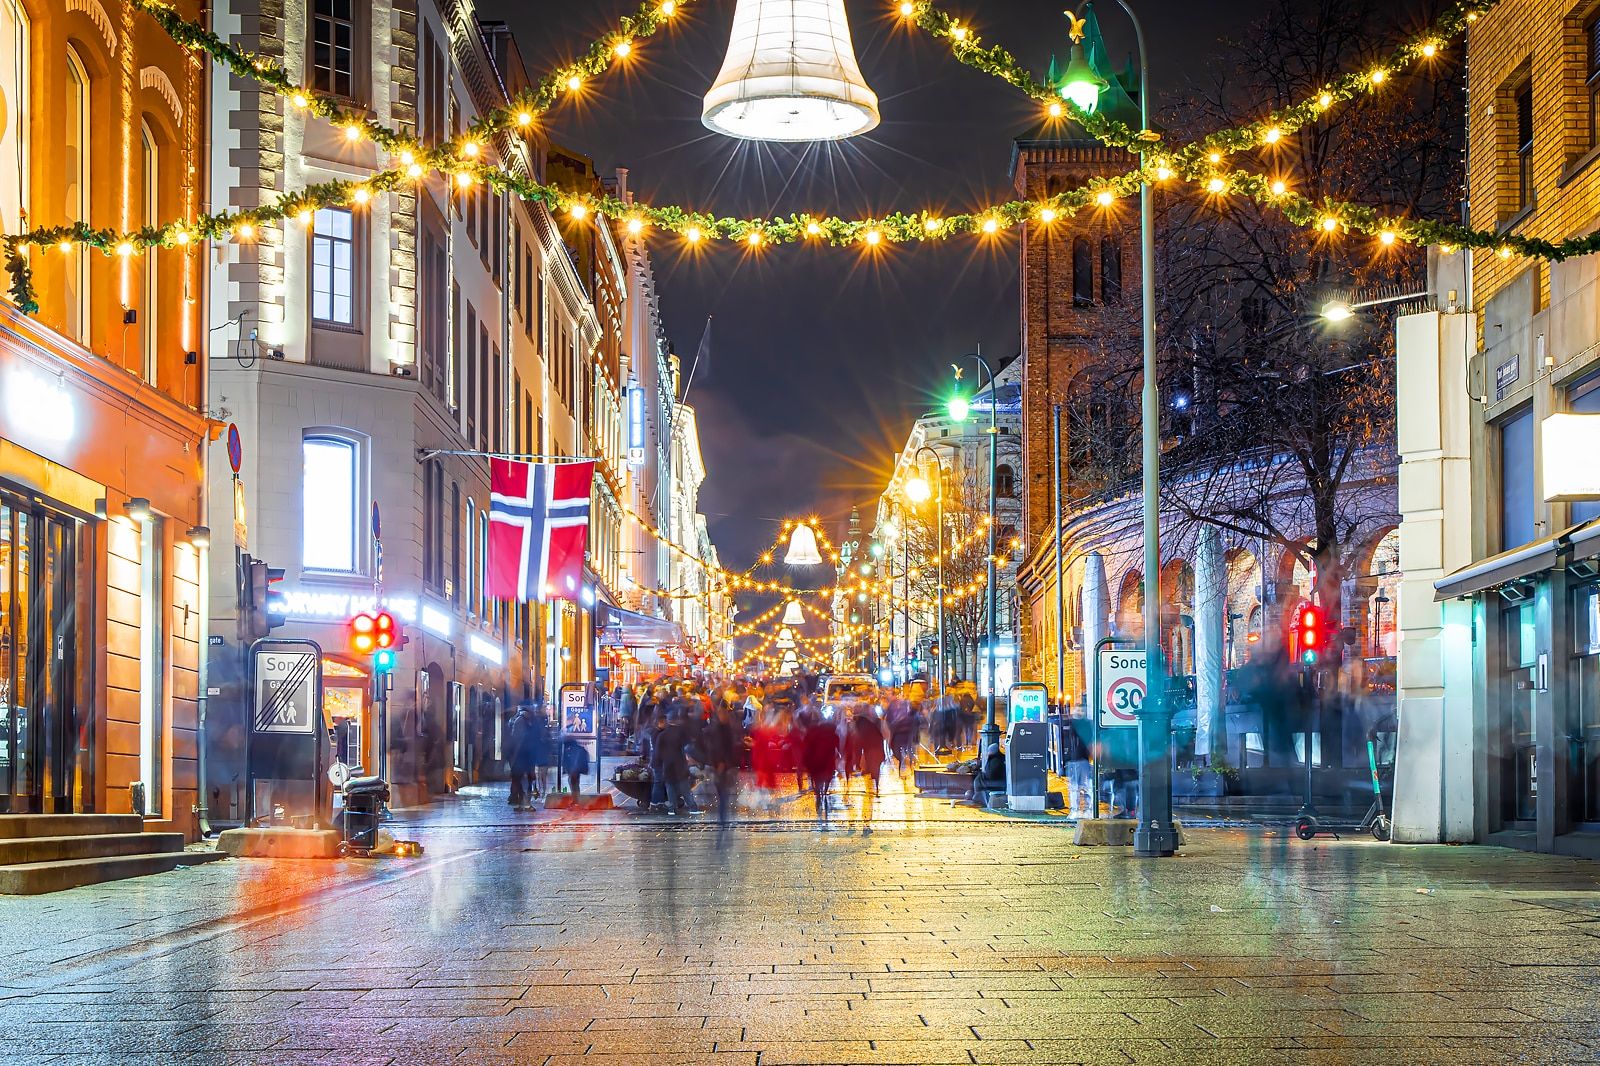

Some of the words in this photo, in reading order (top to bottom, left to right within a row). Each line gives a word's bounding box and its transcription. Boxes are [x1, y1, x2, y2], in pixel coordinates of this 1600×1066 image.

[1110, 655, 1146, 669] Sone
[569, 694, 586, 702] Son
[1018, 692, 1039, 702] one
[1115, 688, 1142, 709] 30
